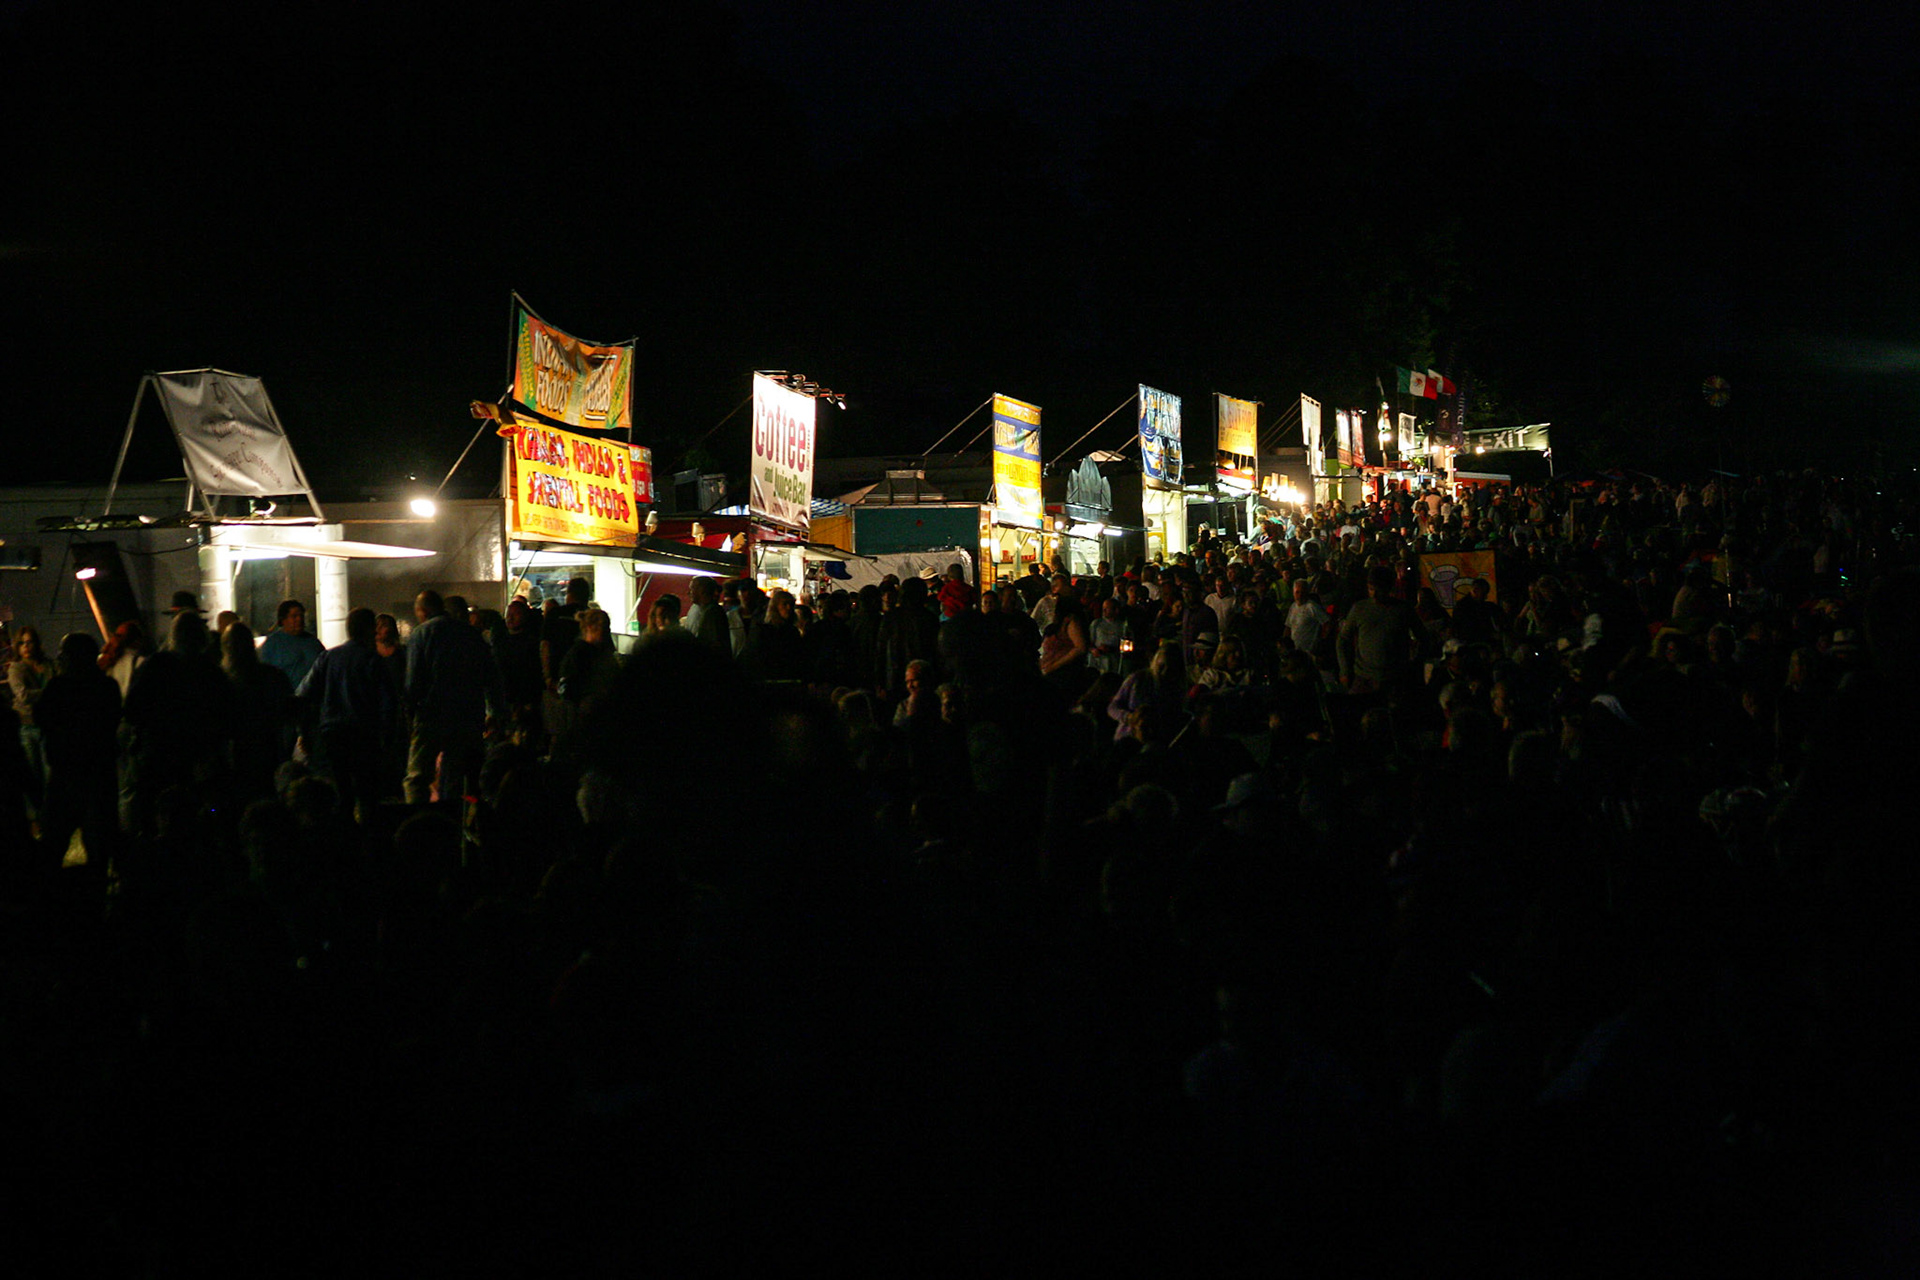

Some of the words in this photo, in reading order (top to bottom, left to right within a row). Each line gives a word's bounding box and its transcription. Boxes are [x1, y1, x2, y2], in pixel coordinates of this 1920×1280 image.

[535, 370, 571, 414] FOODS
[755, 392, 806, 472] Coffee
[1479, 429, 1528, 449] EXIT
[572, 439, 615, 479] INDIAN
[617, 453, 628, 485] &
[588, 484, 631, 524] FOODS
[764, 467, 774, 484] and
[773, 467, 792, 501] Juice
[792, 474, 806, 505] Bar
